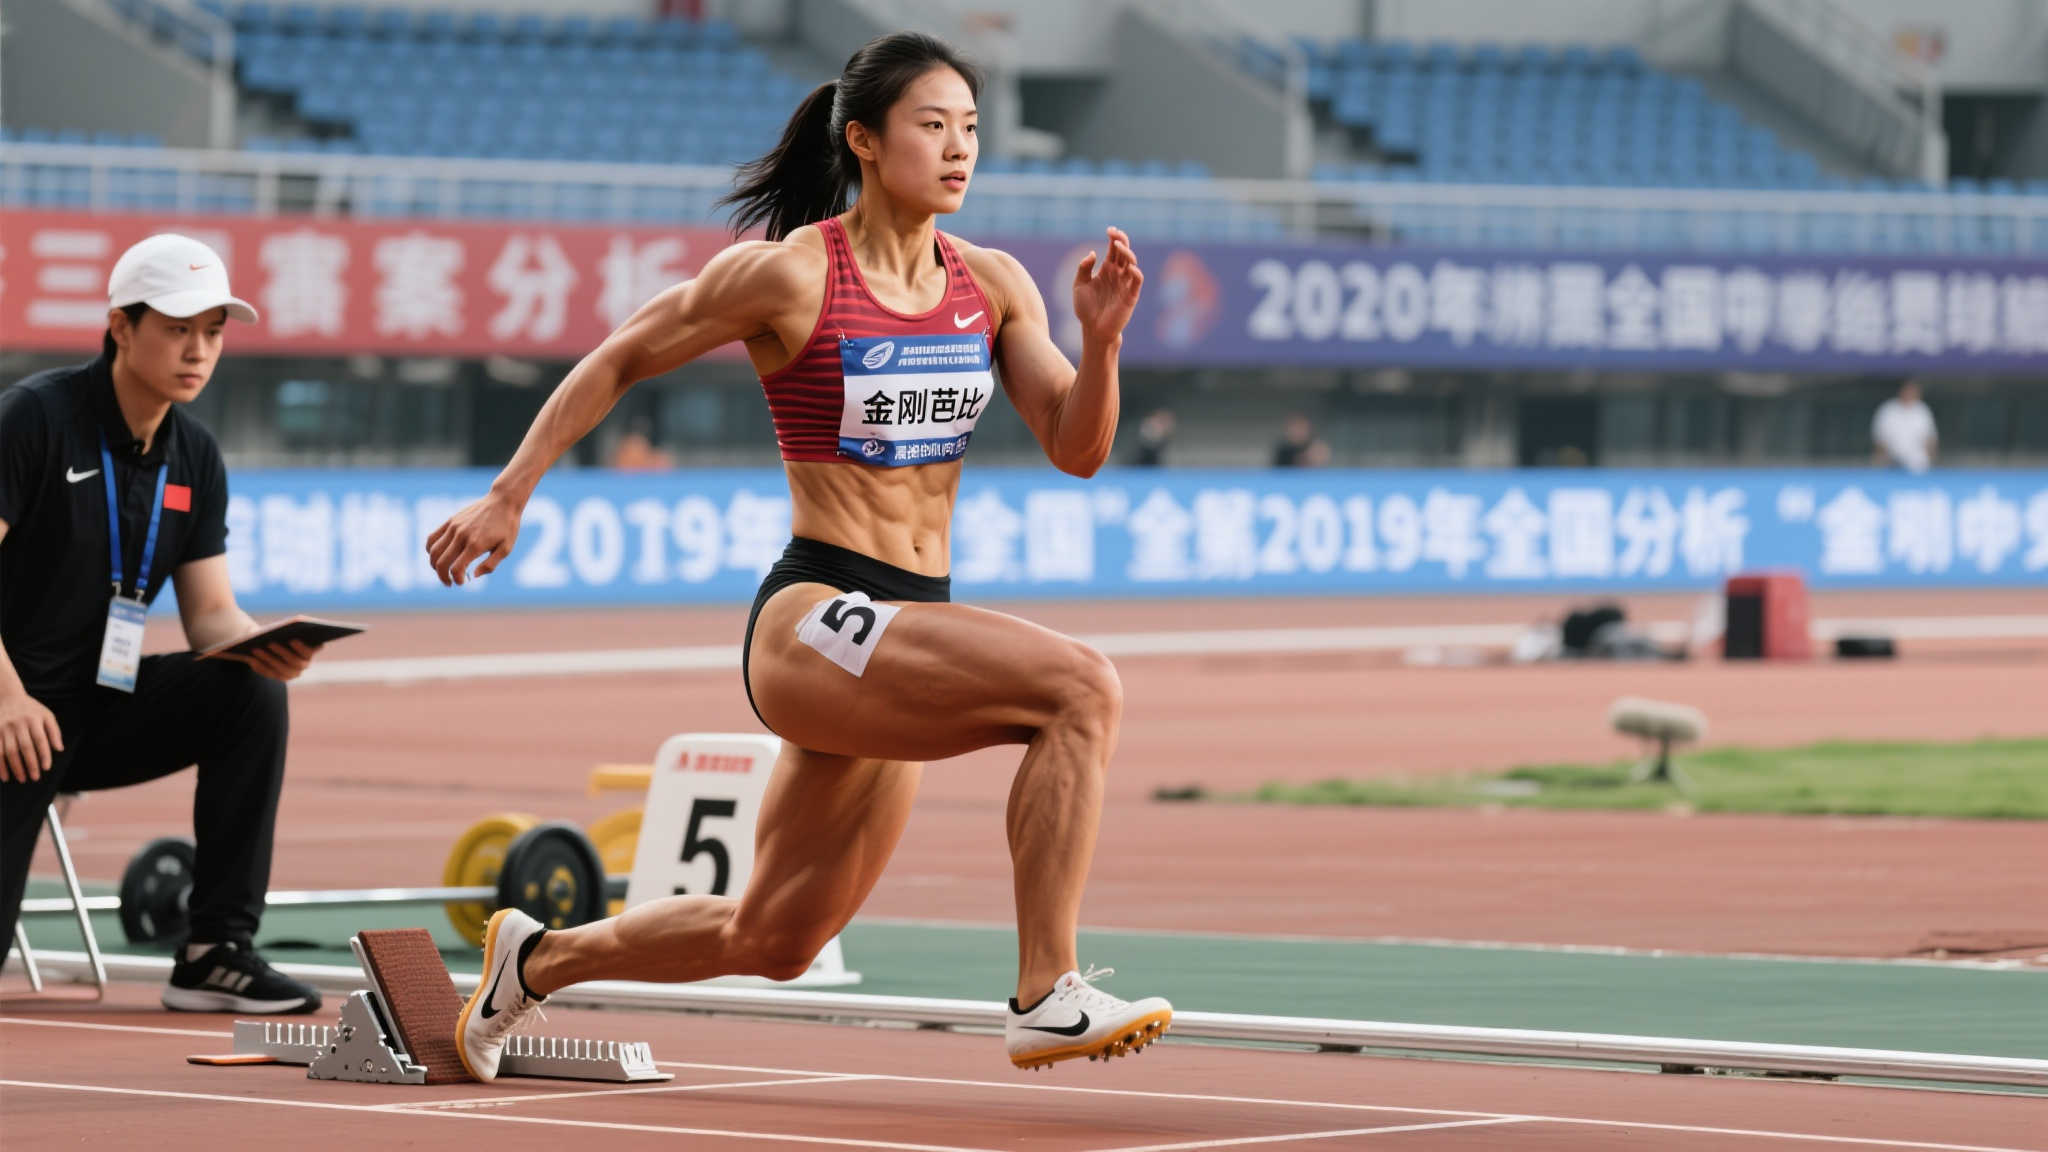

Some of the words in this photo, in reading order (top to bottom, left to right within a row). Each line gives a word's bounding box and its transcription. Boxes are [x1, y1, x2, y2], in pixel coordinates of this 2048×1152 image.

[862, 387, 984, 425] 金刚芭比
[820, 598, 876, 646] 5
[673, 798, 737, 897] 5
